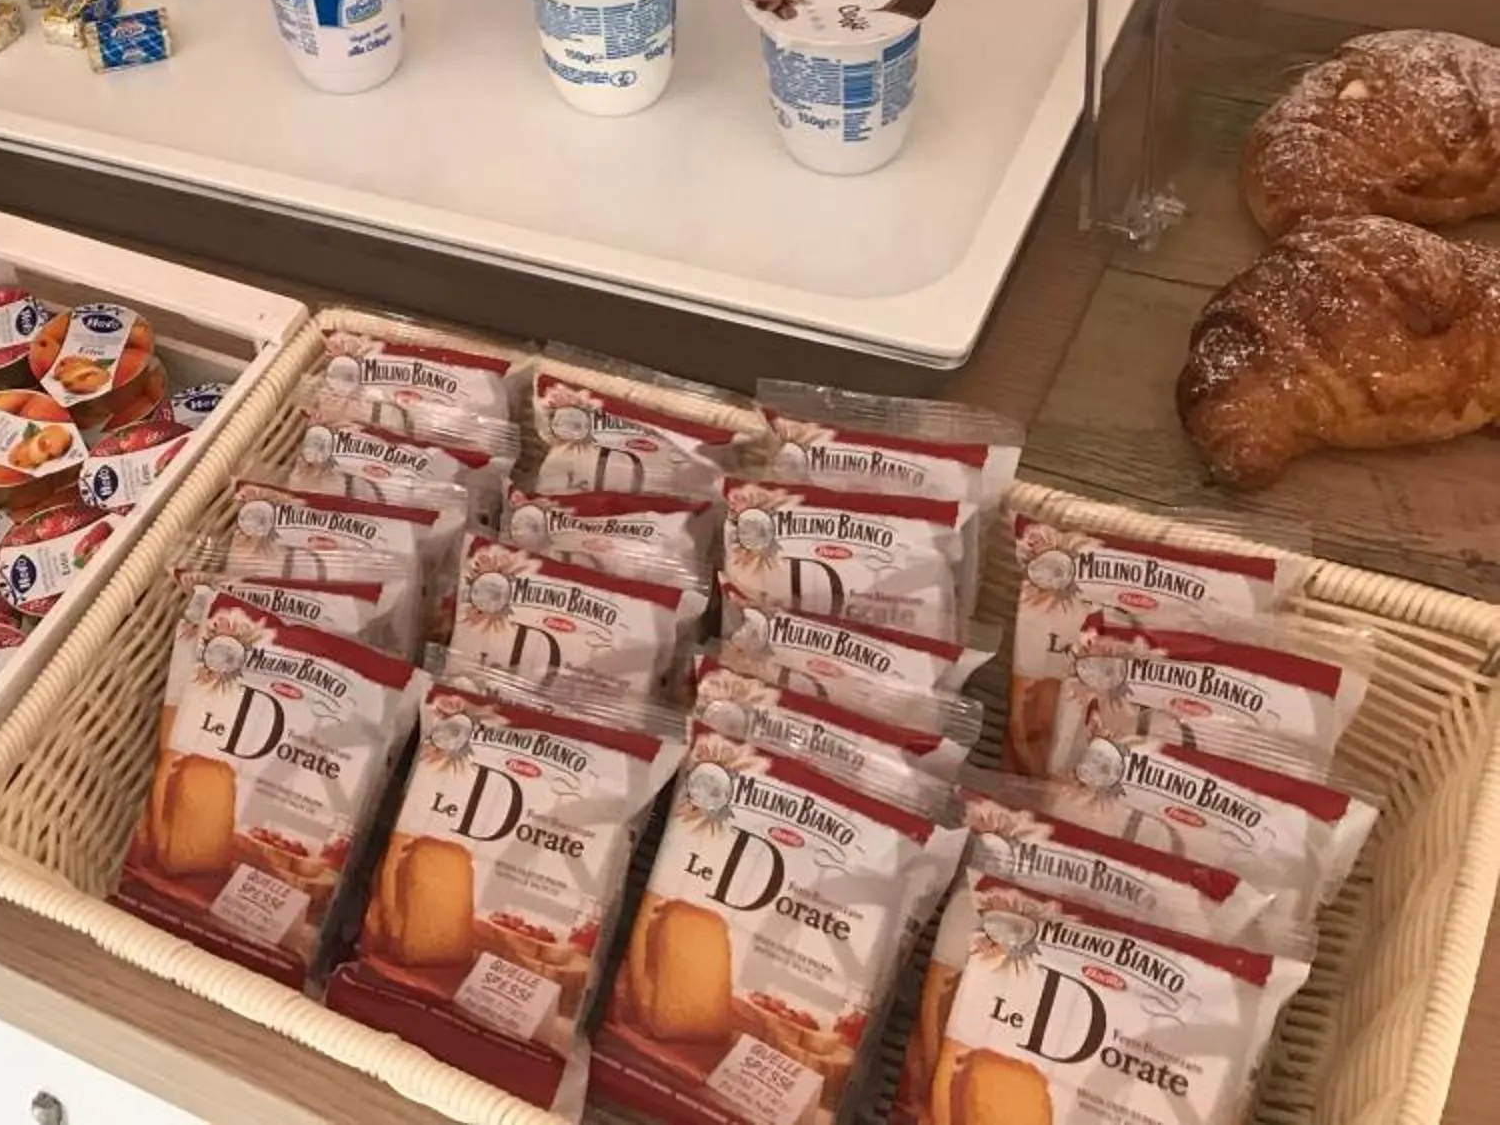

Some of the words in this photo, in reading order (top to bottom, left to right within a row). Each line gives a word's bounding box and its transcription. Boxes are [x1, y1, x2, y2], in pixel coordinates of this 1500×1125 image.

[364, 359, 411, 383] MULINO
[411, 363, 457, 394] BIANCO
[336, 431, 385, 458] MULINO
[811, 446, 869, 475] MULINO
[870, 451, 925, 487] BIANCO
[278, 504, 328, 527] MULINO
[327, 514, 377, 541] BIANCO
[602, 519, 655, 537] BIANCO
[777, 510, 837, 539] MULINO
[837, 513, 894, 548] BIANCO
[512, 577, 567, 609] MULINO
[566, 587, 617, 626] BIANCO
[1078, 551, 1141, 584] MULINO
[1143, 560, 1206, 601] BIANCO
[270, 589, 321, 621] BIANCO
[772, 616, 833, 652] MULINO
[833, 630, 891, 674] BIANCO
[246, 648, 299, 675] MULINO
[296, 658, 347, 699] BIANCO
[1130, 658, 1197, 689] MULINO
[1199, 666, 1264, 712] BIANCO
[200, 712, 226, 736] Le
[217, 684, 342, 779] Dorate
[473, 722, 534, 751] MULINO
[532, 734, 587, 773] BIANCO
[431, 791, 459, 817] Le
[450, 761, 585, 859] Dorate
[734, 776, 798, 818] MULINO
[797, 796, 855, 847] BIANCO
[1126, 752, 1197, 801] MULINO
[1196, 778, 1262, 829] BIANCO
[684, 852, 714, 881] Le
[705, 825, 852, 942] Dorate
[1017, 842, 1089, 880] MULINO
[1089, 859, 1157, 911] BIANCO
[1039, 921, 1115, 958] MULINO
[1115, 938, 1186, 994] BIANCO
[990, 996, 1025, 1028] Le
[1016, 963, 1190, 1097] Dorate
[749, 1043, 802, 1078] QUELLE
